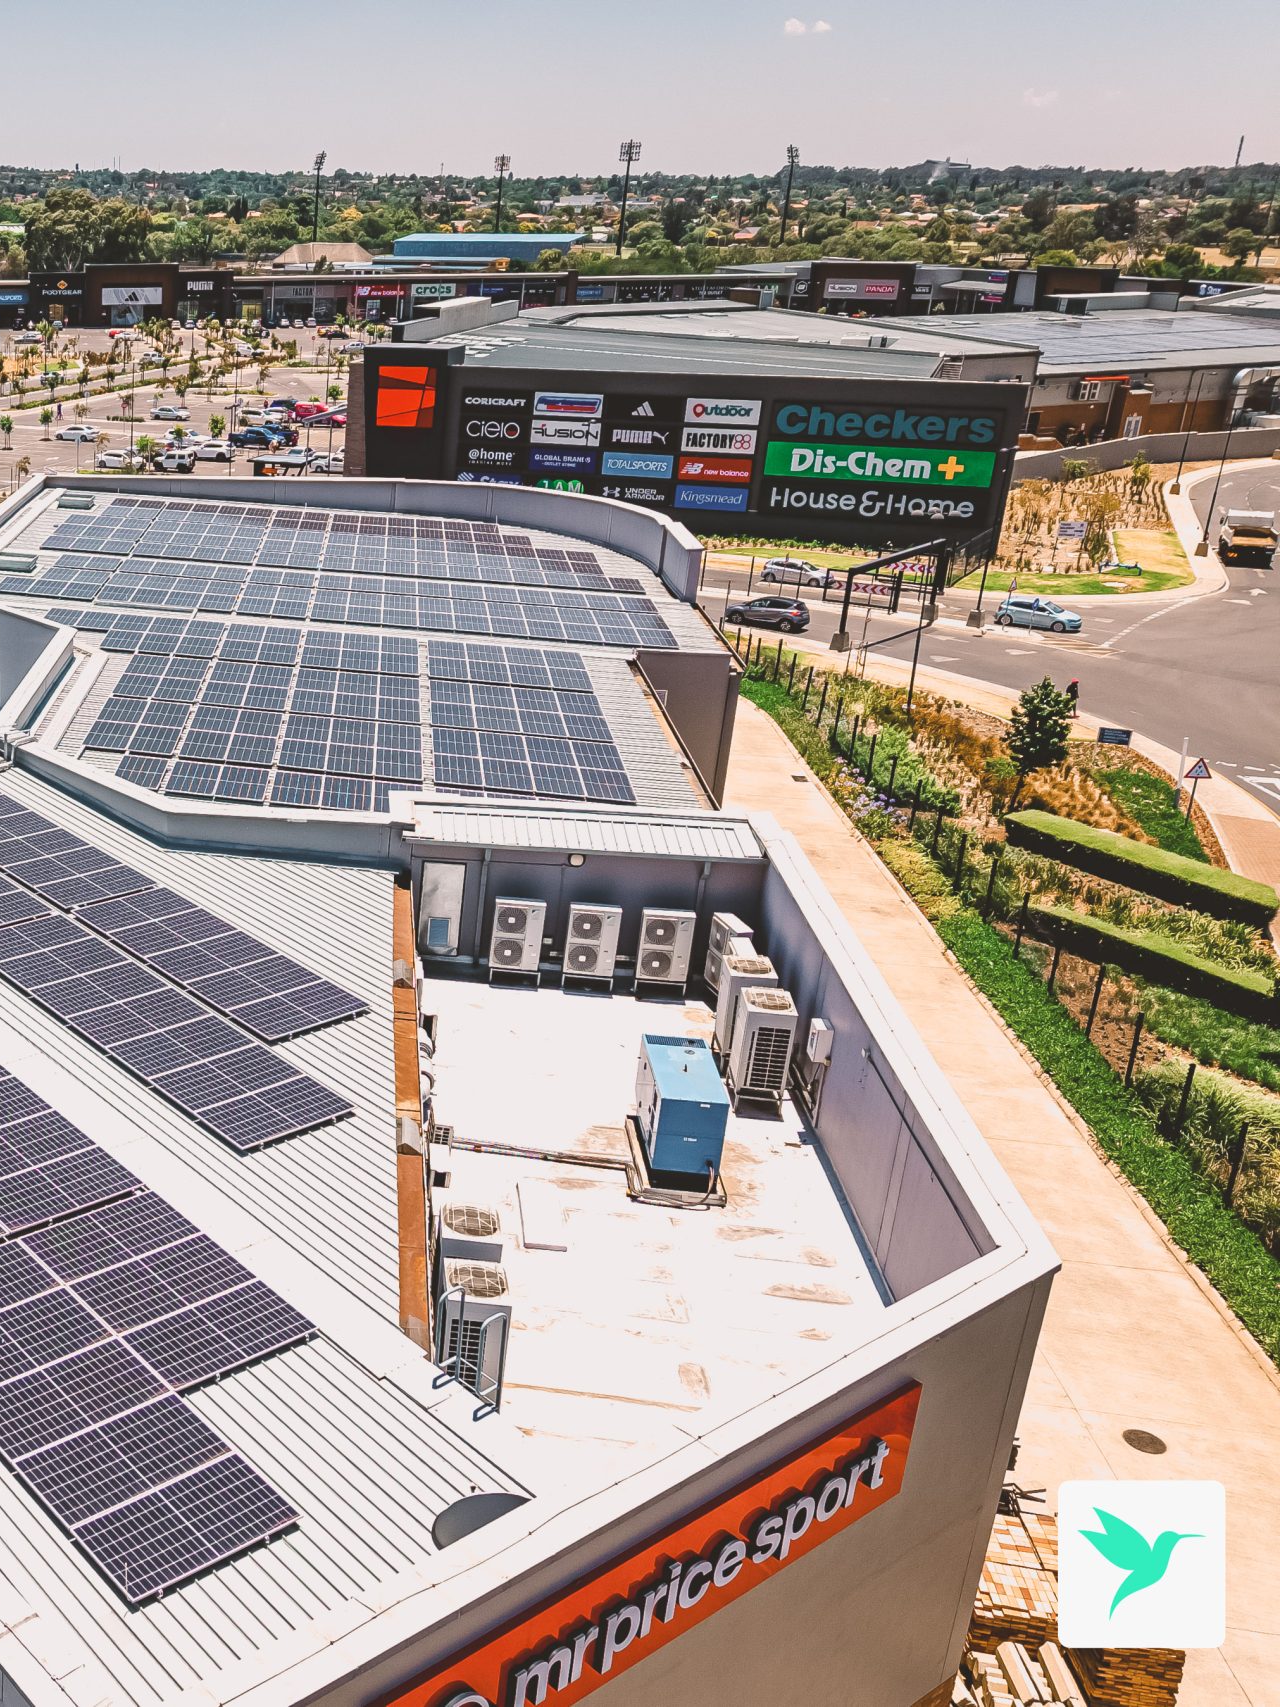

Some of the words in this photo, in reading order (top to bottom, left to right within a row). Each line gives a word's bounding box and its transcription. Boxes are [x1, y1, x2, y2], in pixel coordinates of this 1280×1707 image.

[187, 281, 214, 291] PUMA
[415, 285, 452, 295] crocs
[465, 396, 527, 407] CORICRAFT
[775, 404, 996, 444] Checkers
[612, 429, 653, 444] PUMA
[468, 448, 513, 461] @home
[534, 454, 562, 462] GLOBAL
[607, 459, 668, 472] TOTALSPORTS
[790, 448, 932, 480] Dis-Chem
[703, 468, 719, 476] new
[719, 468, 749, 477] balance
[624, 487, 657, 495] UNDER
[680, 490, 743, 505] Kingsmead
[751, 1439, 890, 1564] sport
